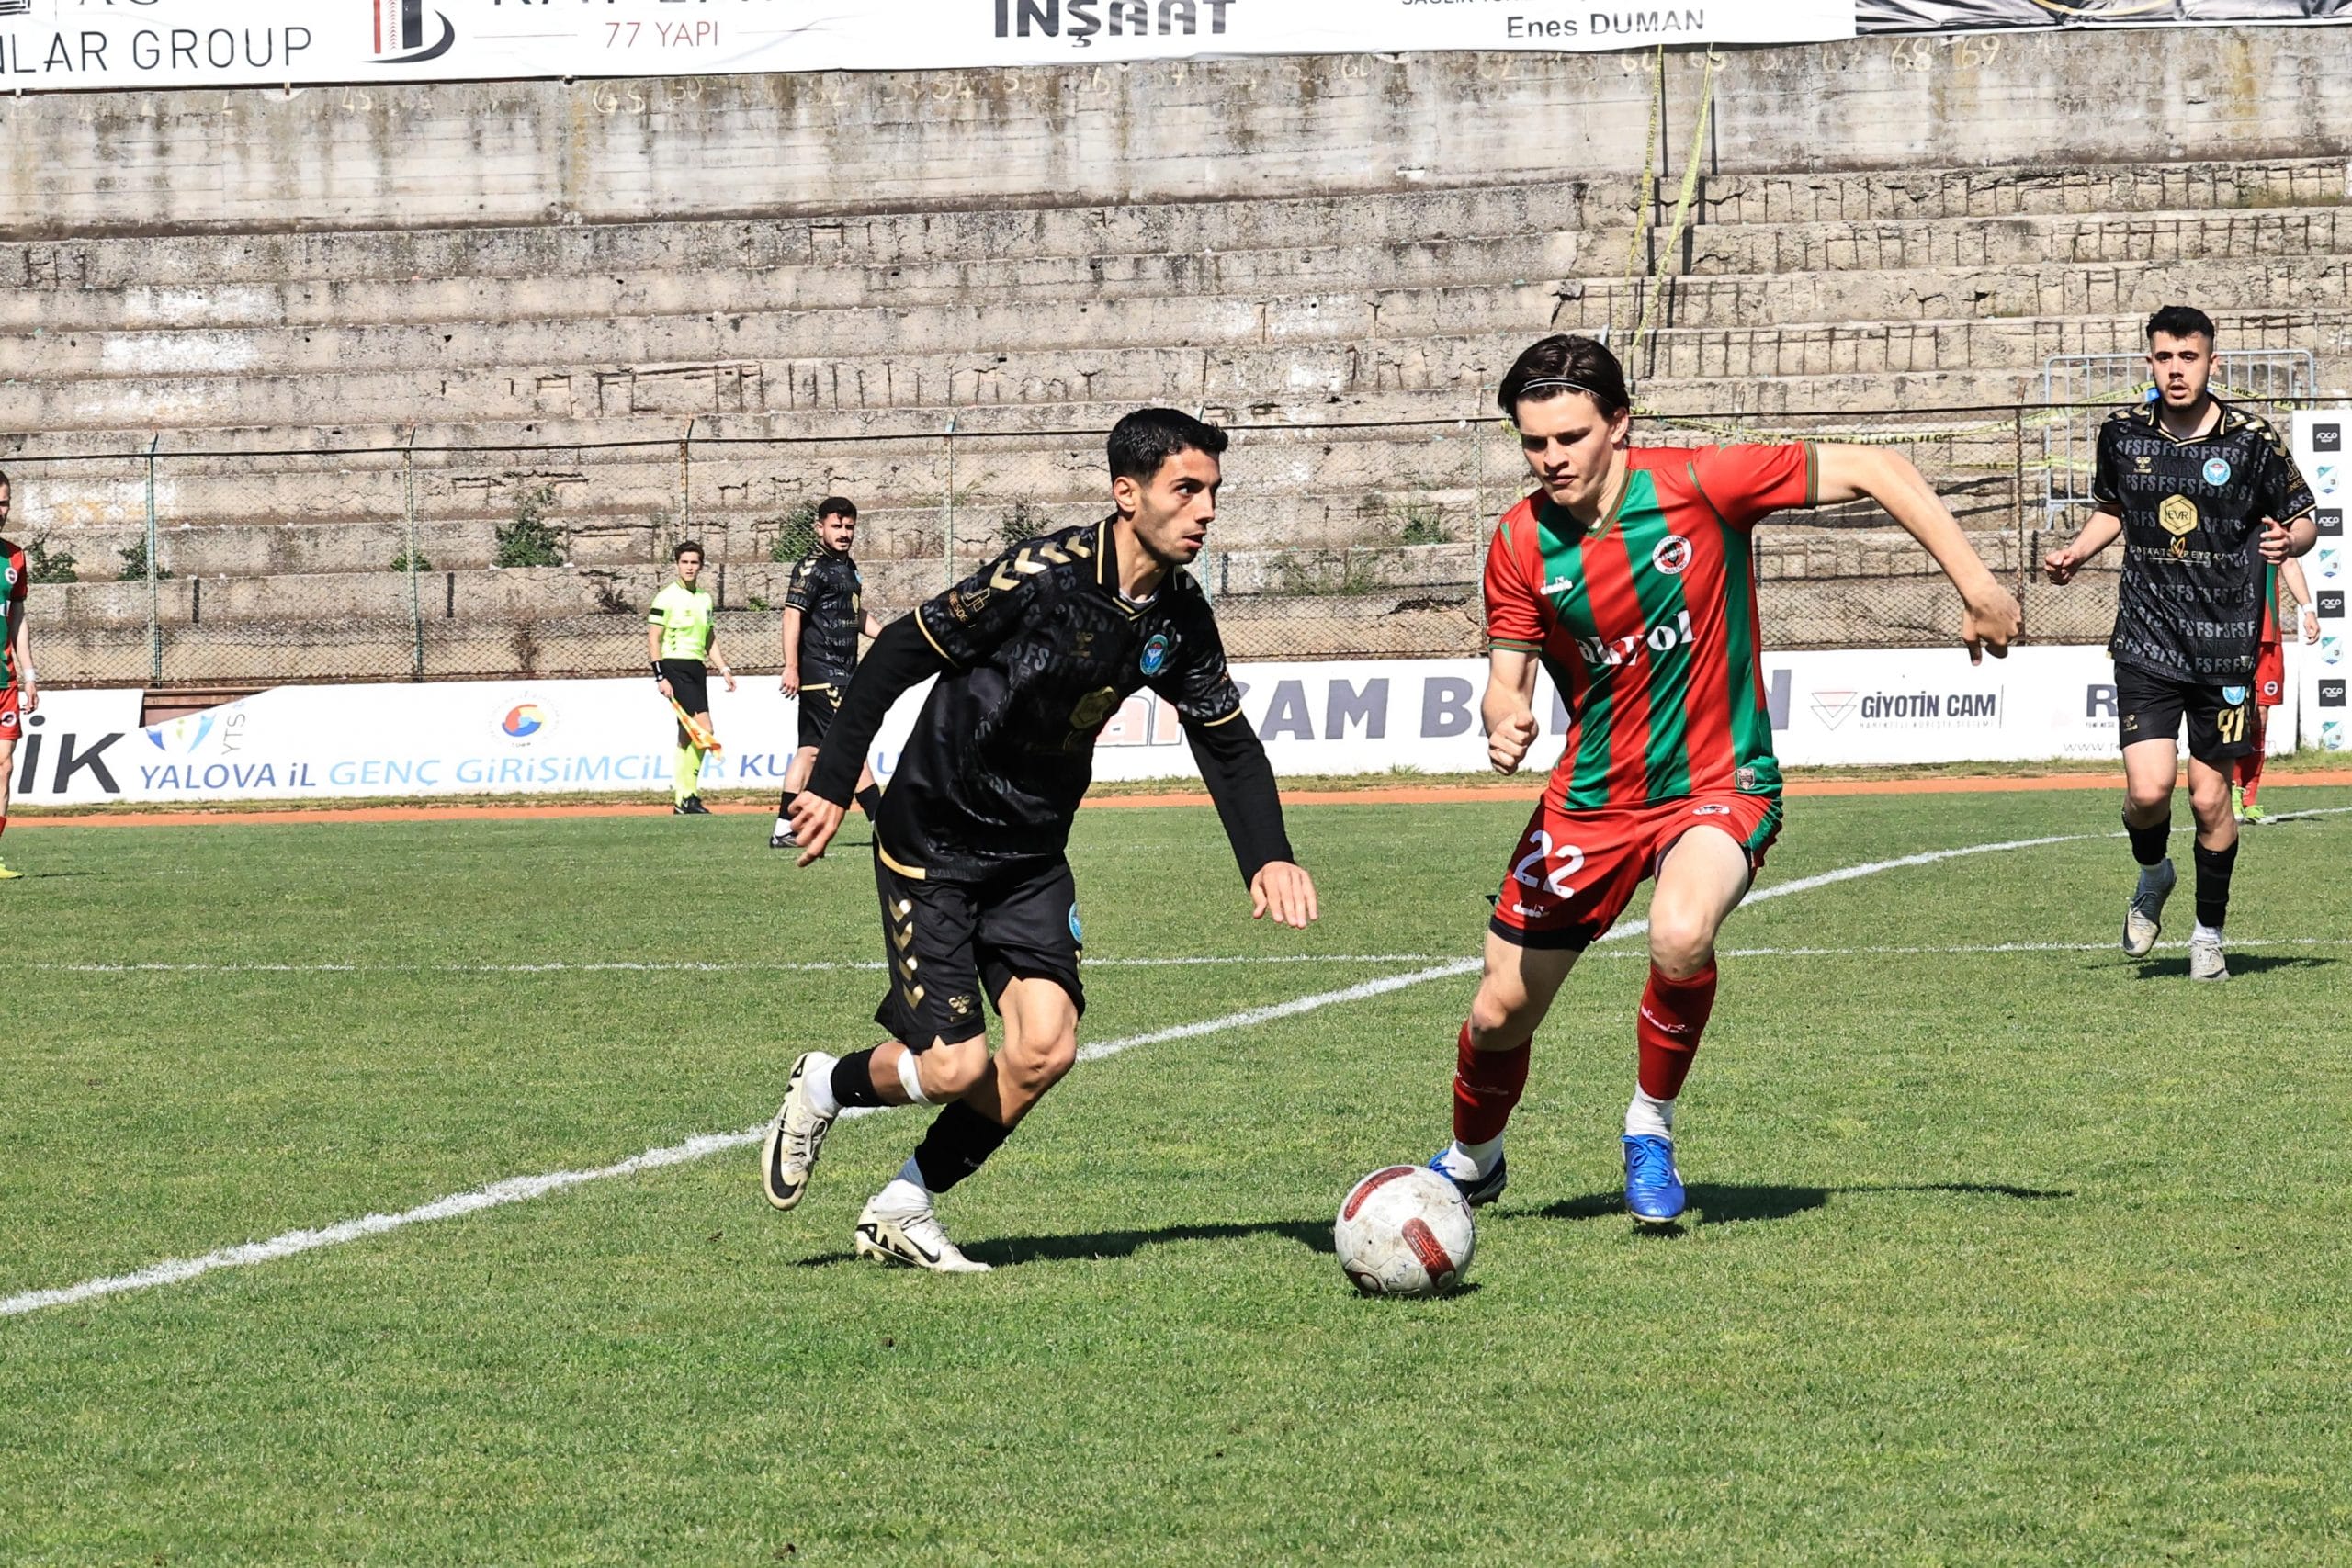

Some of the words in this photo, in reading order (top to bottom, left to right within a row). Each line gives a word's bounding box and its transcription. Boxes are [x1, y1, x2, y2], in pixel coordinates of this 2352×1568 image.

[605, 22, 640, 48] 77
[655, 21, 718, 48] YAPI
[1507, 16, 1577, 39] Enes
[1590, 10, 1704, 35] DUMAN
[132, 27, 311, 70] GROUP
[2168, 510, 2188, 521] EVR
[1236, 677, 1390, 741] AM
[1861, 690, 1940, 719] GİYOTİN
[1947, 694, 1996, 717] CAM
[2216, 705, 2245, 745] 91
[140, 763, 277, 790] YALOVA
[329, 760, 441, 787] GENÇ
[1512, 829, 1586, 900] 22
